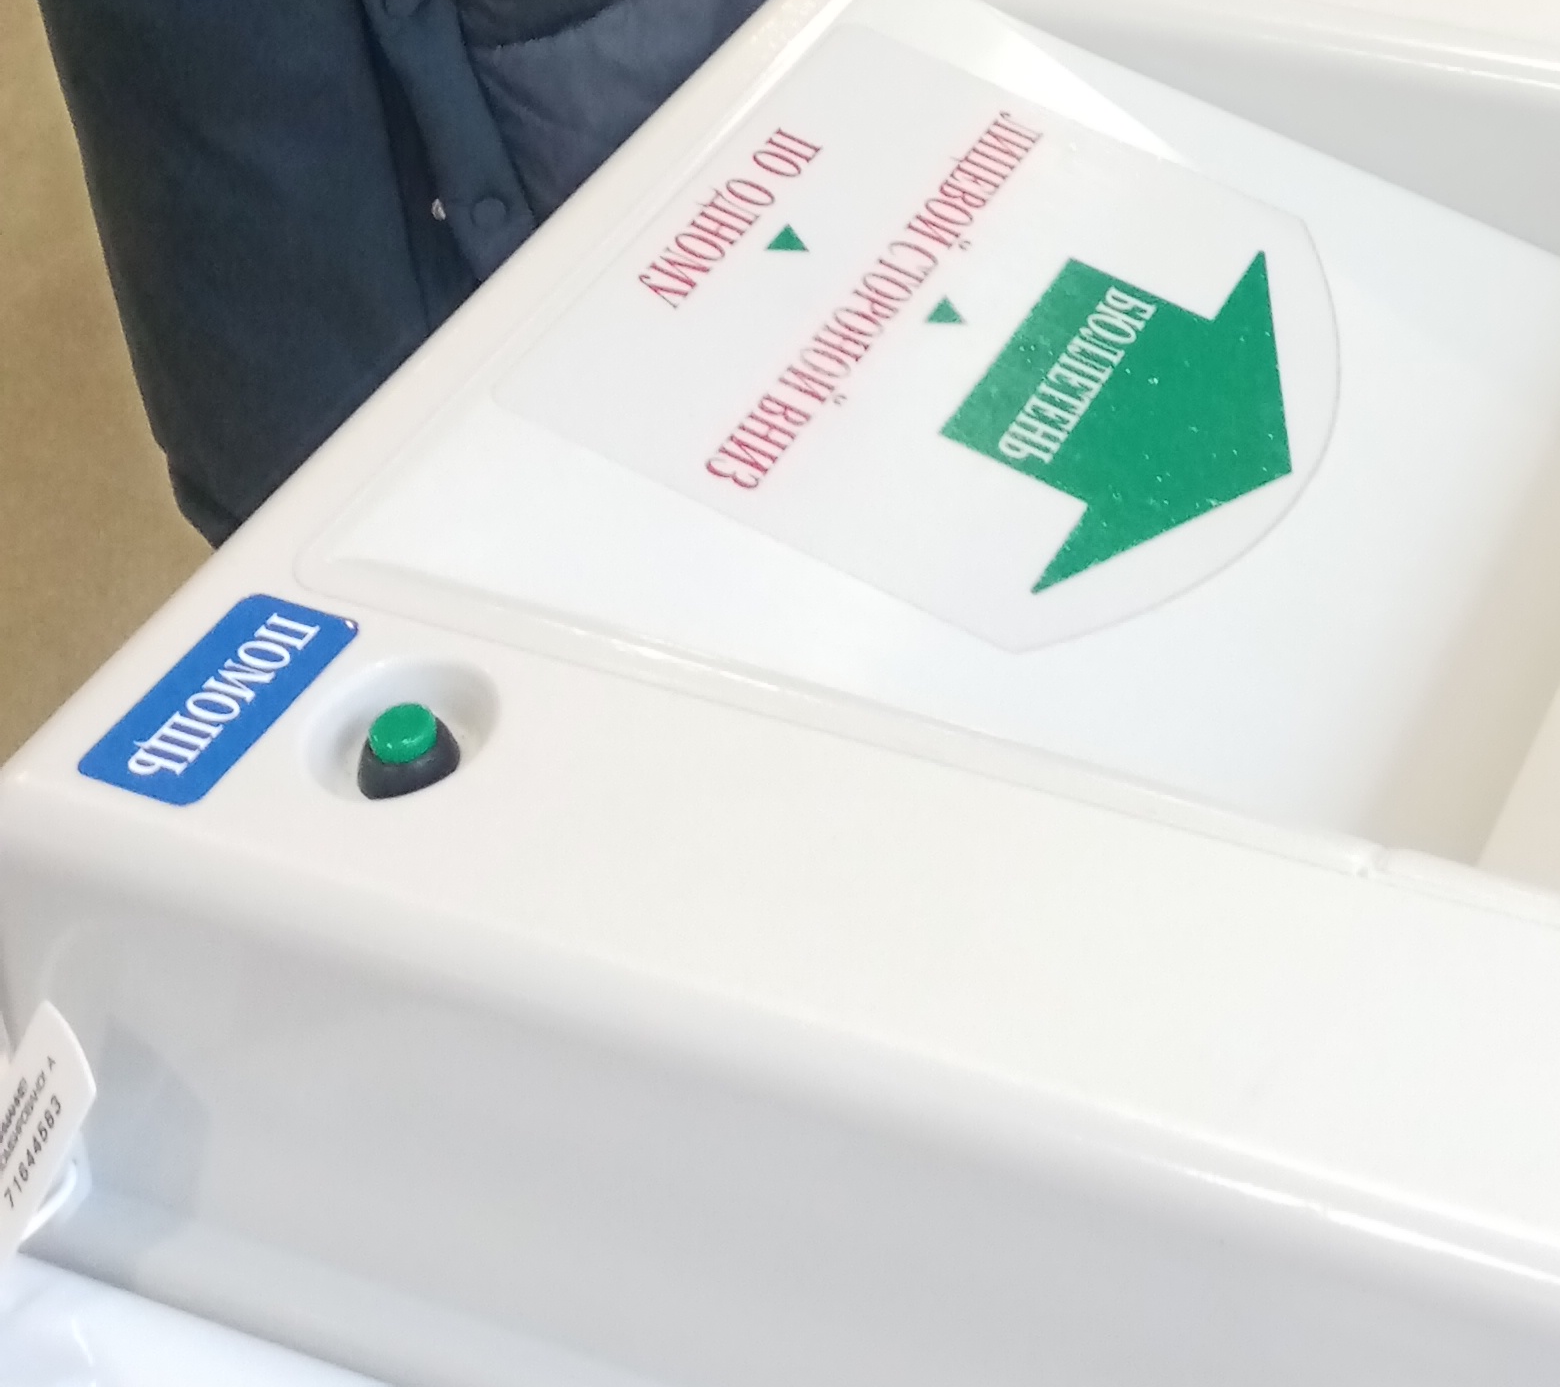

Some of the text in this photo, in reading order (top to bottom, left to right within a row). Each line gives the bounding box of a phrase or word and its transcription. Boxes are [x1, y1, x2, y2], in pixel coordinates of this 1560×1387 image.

[639, 127, 823, 309] ПО ОДНОМУ
[705, 110, 1044, 490] ЛИЦЕВОЙ СТОРОНОЙ ВНИЗ
[998, 285, 1157, 464] БЮЛЛЕТЕНЬ
[127, 612, 321, 776] ПОМОЩЬ
